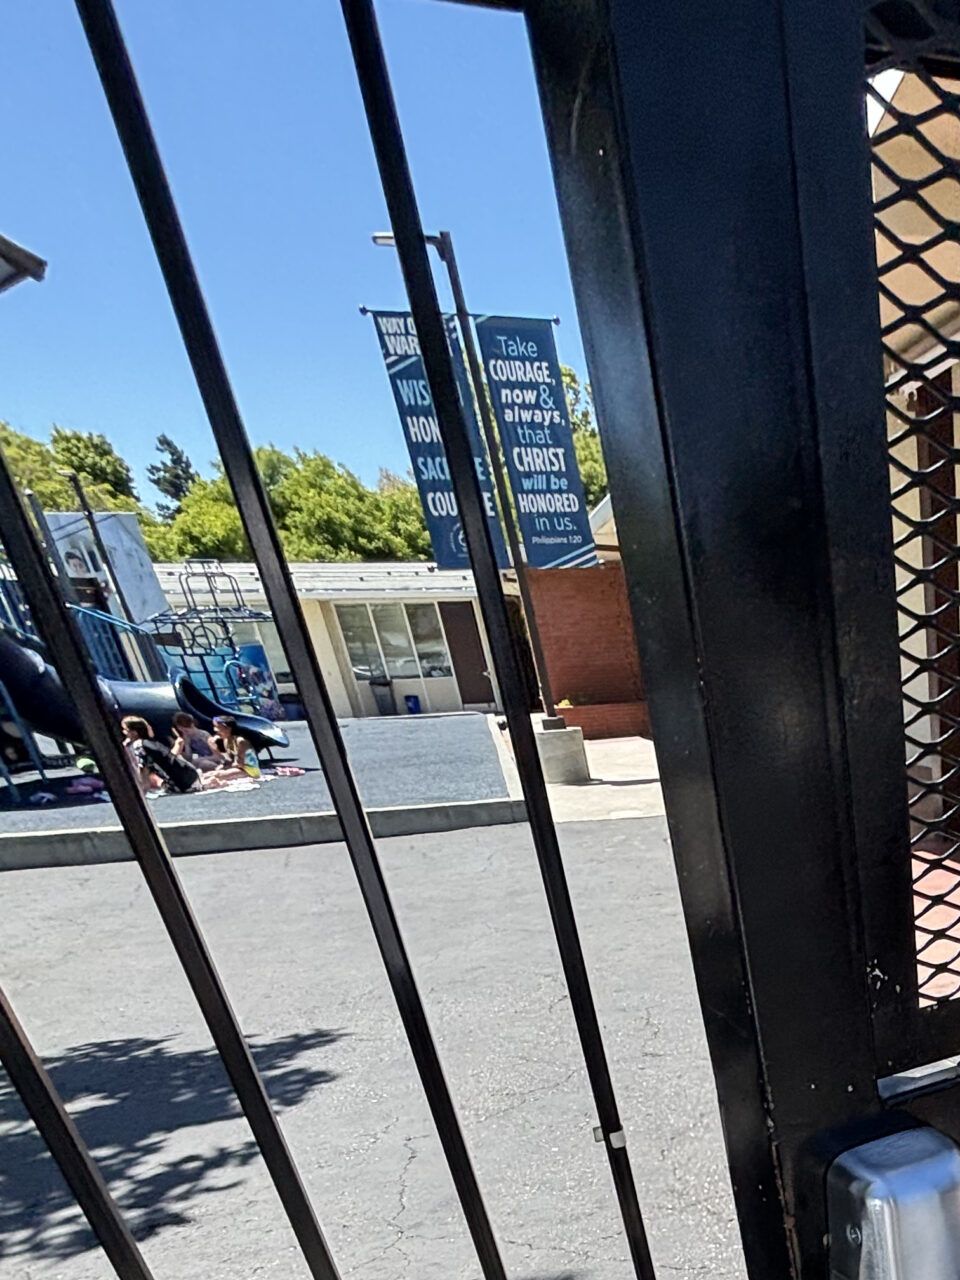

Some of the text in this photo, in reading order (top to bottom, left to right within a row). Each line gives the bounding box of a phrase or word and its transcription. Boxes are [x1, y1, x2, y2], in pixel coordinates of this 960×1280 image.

[496, 335, 538, 357] Take
[489, 359, 556, 386] COURAGE,
[501, 384, 556, 409] now &
[504, 405, 566, 426] always,
[516, 424, 553, 444] that
[512, 446, 566, 472] CHRIST
[521, 473, 568, 491] will be
[517, 492, 579, 514] HONORED
[534, 513, 577, 531] in us.
